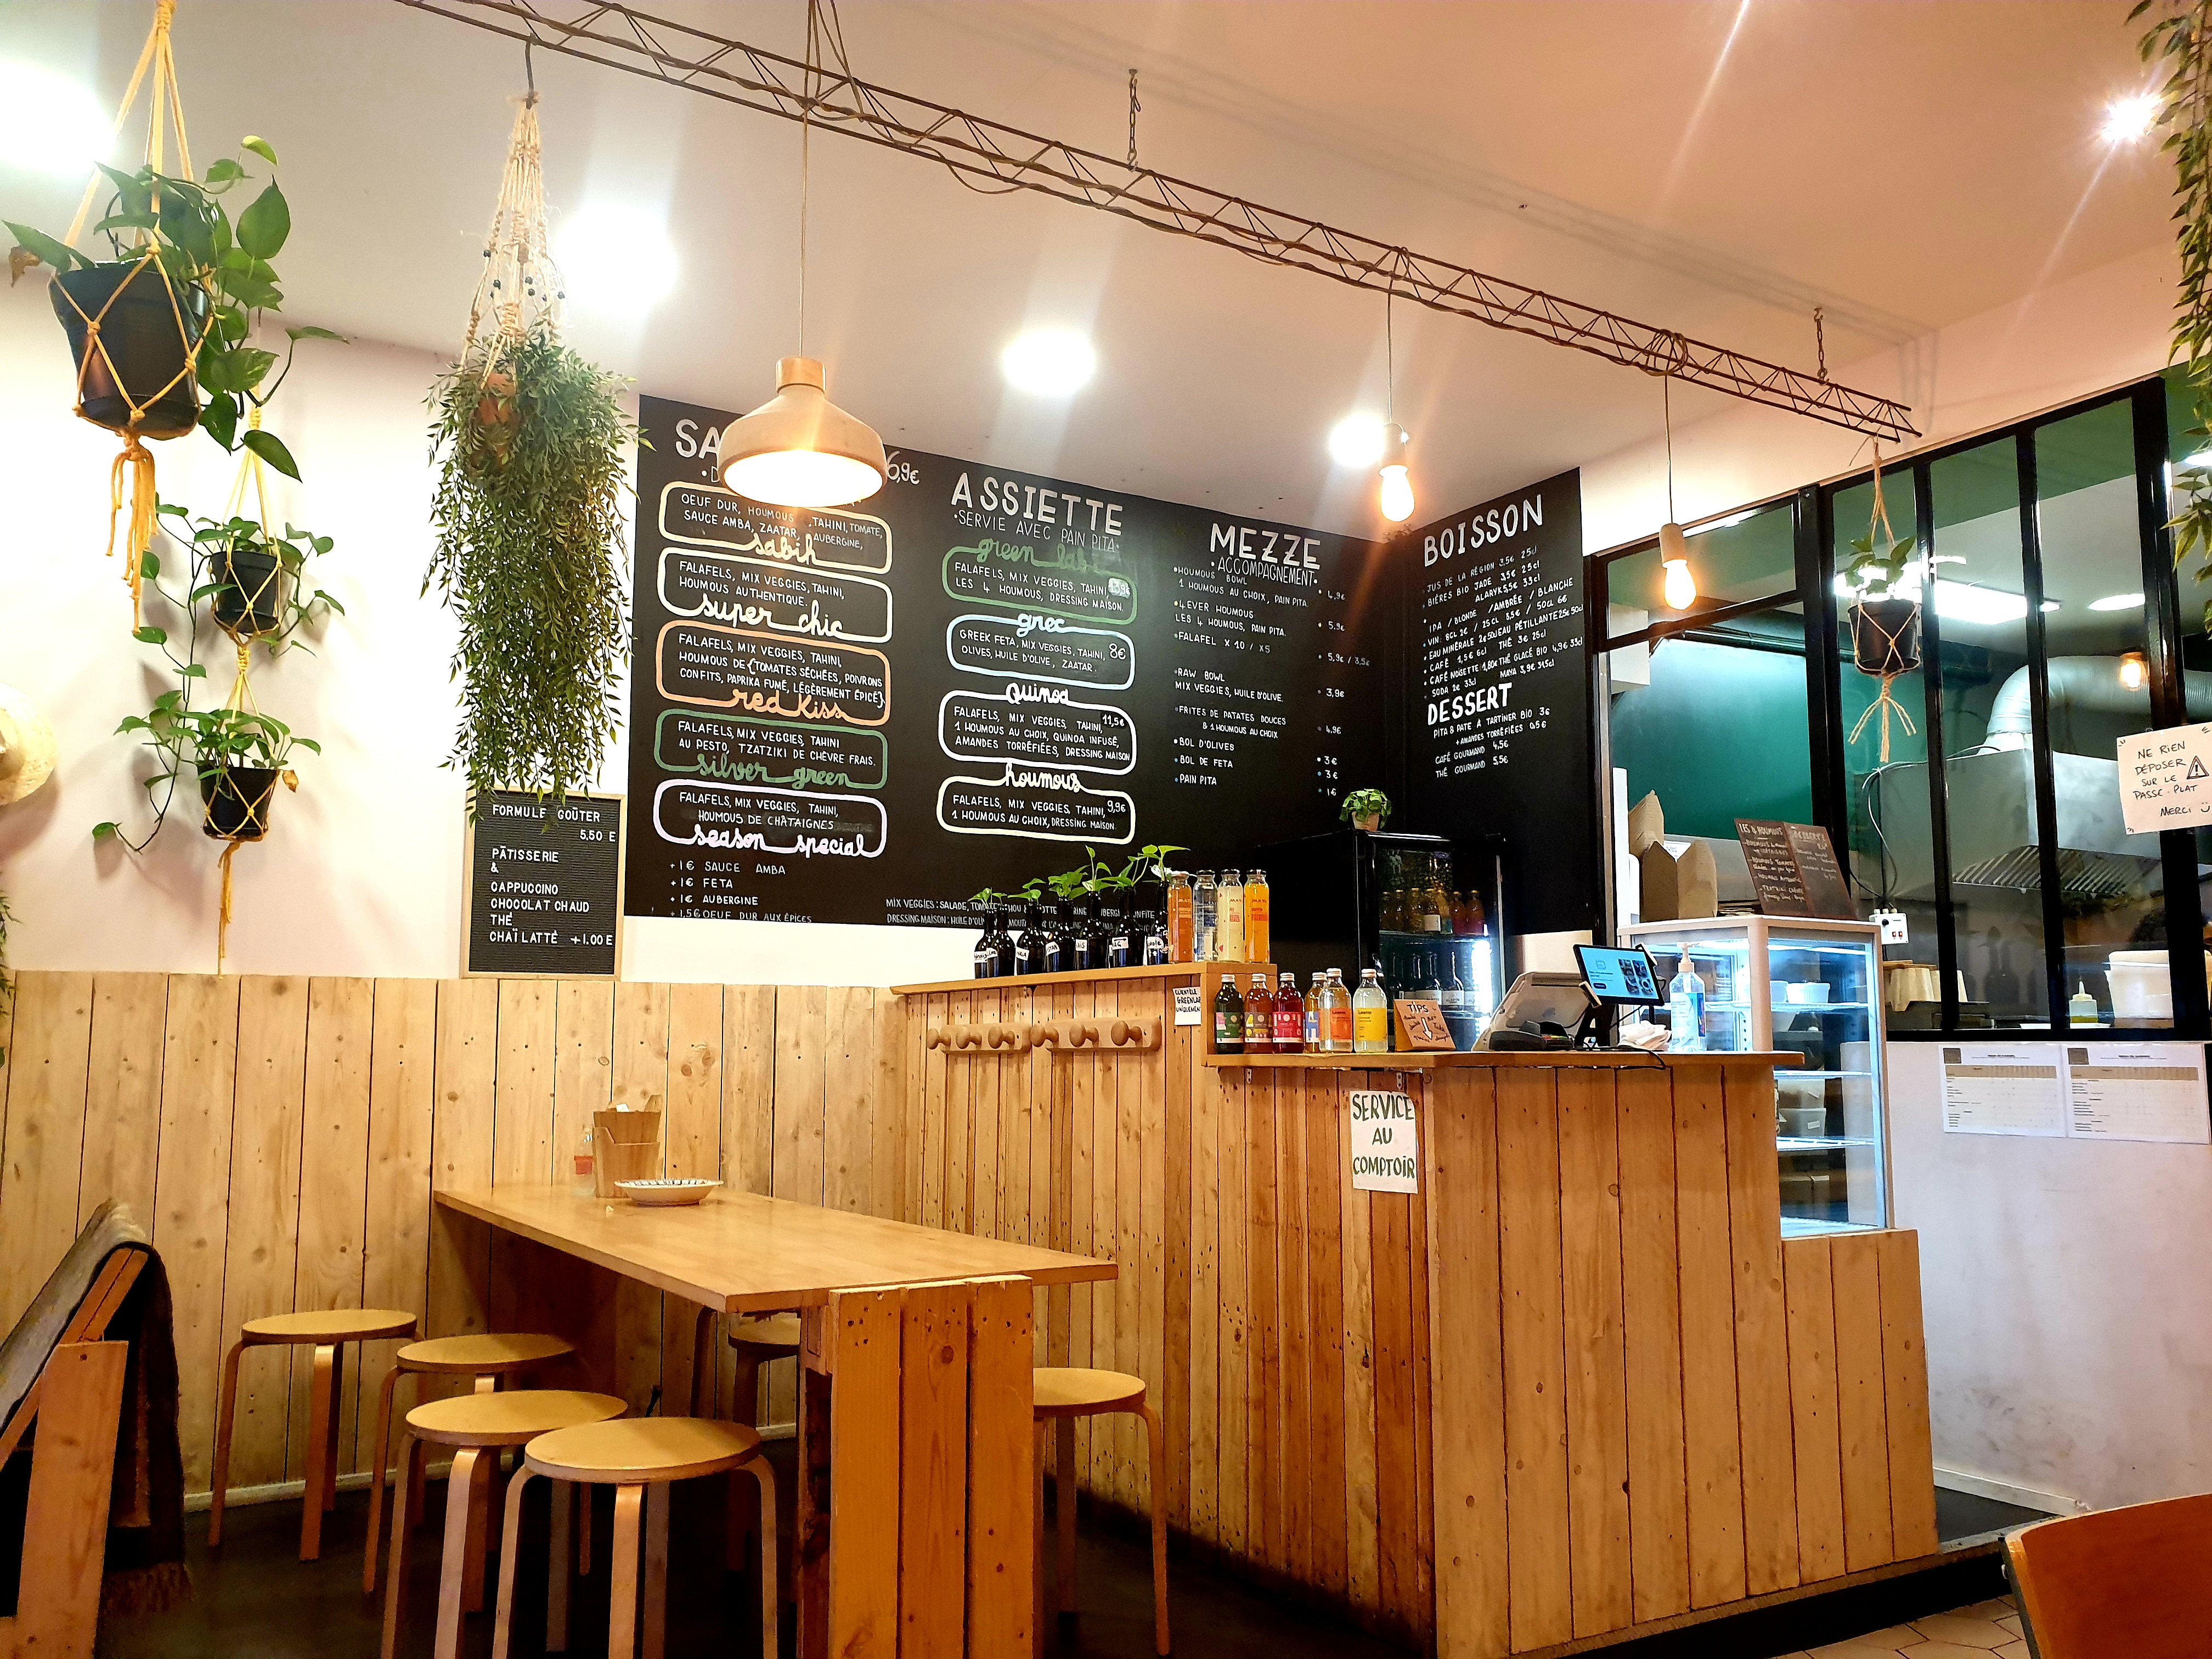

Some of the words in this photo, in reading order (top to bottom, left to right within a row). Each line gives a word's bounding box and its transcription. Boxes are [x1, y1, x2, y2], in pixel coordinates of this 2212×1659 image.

[681, 494, 711, 507] OEUF
[717, 498, 741, 514] DUR,
[748, 506, 794, 522] HOUMOUS
[850, 523, 883, 538] TOMATE,
[951, 472, 1123, 536] ASSIETTE
[684, 510, 718, 524] SAUCE
[722, 516, 754, 533] AMBA,
[760, 523, 800, 539] ZAATAR,
[814, 534, 862, 549] AUBERGINE,
[1016, 521, 1051, 540] AVEC
[1061, 528, 1085, 547] PAIN
[1424, 494, 1543, 567] BOISSON
[750, 533, 817, 565] sabih
[977, 538, 1035, 563] green
[1210, 523, 1321, 569] MEZZE
[679, 561, 736, 581] FALAFELS,
[742, 572, 760, 583] MIX
[764, 574, 810, 593] VEGGIES,
[811, 583, 844, 600] TAHINI,
[679, 577, 729, 594] HOUMOUS
[736, 586, 808, 606] AUTHENTIQUE.
[955, 562, 1005, 581] FALAFELS,
[1009, 572, 1028, 583] MIX
[1034, 575, 1076, 592] VEGGIES,
[1080, 583, 1109, 599] TAHINI,
[956, 578, 973, 589] LES
[983, 582, 990, 593] 4
[1000, 584, 1043, 601] HOUMOUS,
[1049, 594, 1088, 606] DRESSING
[1092, 600, 1124, 611] MAISON.
[699, 593, 774, 628] super
[798, 600, 844, 636] chic
[1216, 606, 1254, 619] HOUMOUS
[1016, 613, 1066, 637] grec
[679, 634, 733, 653] FALAFELS,
[738, 643, 756, 654] MIX
[760, 646, 805, 663] VEGGIES,
[811, 652, 842, 668] TAHINI,
[960, 630, 991, 642] GREEK
[995, 635, 1019, 648] FETA,
[1022, 640, 1036, 650] MIX
[1039, 643, 1075, 656] VEGGIES,
[1077, 648, 1105, 661] TAHINI,
[1109, 643, 1126, 659] 8€
[962, 646, 992, 659] OLIVES,
[995, 650, 1018, 661] HUILE
[679, 652, 727, 667] HOUMOUS
[733, 659, 746, 669] DE
[799, 667, 841, 685] SÉCHÉES,
[845, 673, 882, 687] POIVRONS
[1178, 668, 1196, 678] RAW
[1205, 671, 1225, 681] BOWL
[680, 668, 724, 684] CONFITS,
[727, 675, 760, 687] PAPRIKA
[764, 679, 789, 694] FUMÉ,
[793, 681, 851, 699] LÉGÈREMENT
[731, 689, 780, 714] red
[1427, 682, 1512, 725] DESSERT
[1179, 706, 1206, 716] FRITES
[1210, 709, 1218, 718] DE
[1224, 711, 1255, 721] PATATES
[1261, 715, 1286, 725] DOUCES
[955, 723, 960, 731] 1
[965, 724, 1004, 735] HOUMOUS
[1009, 728, 1020, 737] AU
[1024, 730, 1049, 741] CHOIX,
[1053, 733, 1085, 744] QUINOA
[1089, 736, 1120, 748] INFUSÉ,
[1180, 738, 1194, 747] BOL
[1199, 740, 1234, 751] D'OLIVES
[679, 738, 691, 749] AU
[696, 740, 730, 754] PESTO,
[738, 744, 787, 758] TZATZIKI
[793, 749, 804, 759] DE
[810, 749, 845, 765] CHÈVRE
[849, 754, 876, 765] FRAIS.
[956, 737, 998, 749] AMANDES
[1006, 741, 1059, 758] TORRÉFIÉES,
[1065, 748, 1103, 759] DRESSING
[1105, 751, 1131, 761] MAISON.
[1435, 752, 1451, 764] CAFÉ
[1454, 746, 1485, 759] GOURMAND
[1493, 740, 1509, 750] 4,5€
[2138, 749, 2153, 759] NE
[697, 753, 770, 783] silver
[793, 767, 851, 789] green
[1180, 756, 1194, 765] BOL
[1200, 757, 1208, 766] DE
[1214, 759, 1233, 768] FETA
[1436, 769, 1448, 778] THÉ
[1454, 760, 1485, 775] GOURMAND
[1493, 755, 1508, 765] 5,5€
[2135, 759, 2186, 775] DÉPOSER
[1005, 762, 1081, 793] houmous
[1180, 774, 1196, 783] PAIN
[1200, 777, 1217, 786] PITA
[2142, 778, 2157, 787] SUR
[2165, 775, 2176, 783] LE
[493, 804, 546, 819] FORMULE
[953, 794, 1002, 809] FALAFELS,
[1008, 800, 1024, 809] MIX
[1031, 802, 1070, 815] VEGGIES,
[1076, 805, 1105, 818] TAHINI,
[1107, 800, 1126, 814] 9,9€
[698, 810, 743, 824] HOUMOUS
[748, 815, 762, 825] DE
[768, 815, 833, 830] CHÂTAIGNES
[1739, 823, 1750, 833] LES
[580, 830, 602, 841] 5.50
[610, 831, 616, 842] E
[693, 825, 767, 850] season
[793, 834, 866, 857] special
[491, 862, 499, 873] &
[491, 882, 558, 895] CAPPUCCINO
[491, 898, 550, 911] CHOCOLAT
[554, 901, 590, 912] CHAUD
[490, 912, 512, 926] THÉ
[490, 929, 518, 943] CHAÏ
[522, 930, 558, 944] LATTÉ
[606, 935, 613, 945] E
[1352, 1094, 1414, 1121] SERVICE
[1372, 1127, 1392, 1146] AU
[1353, 1156, 1415, 1179] COMPTOIR
